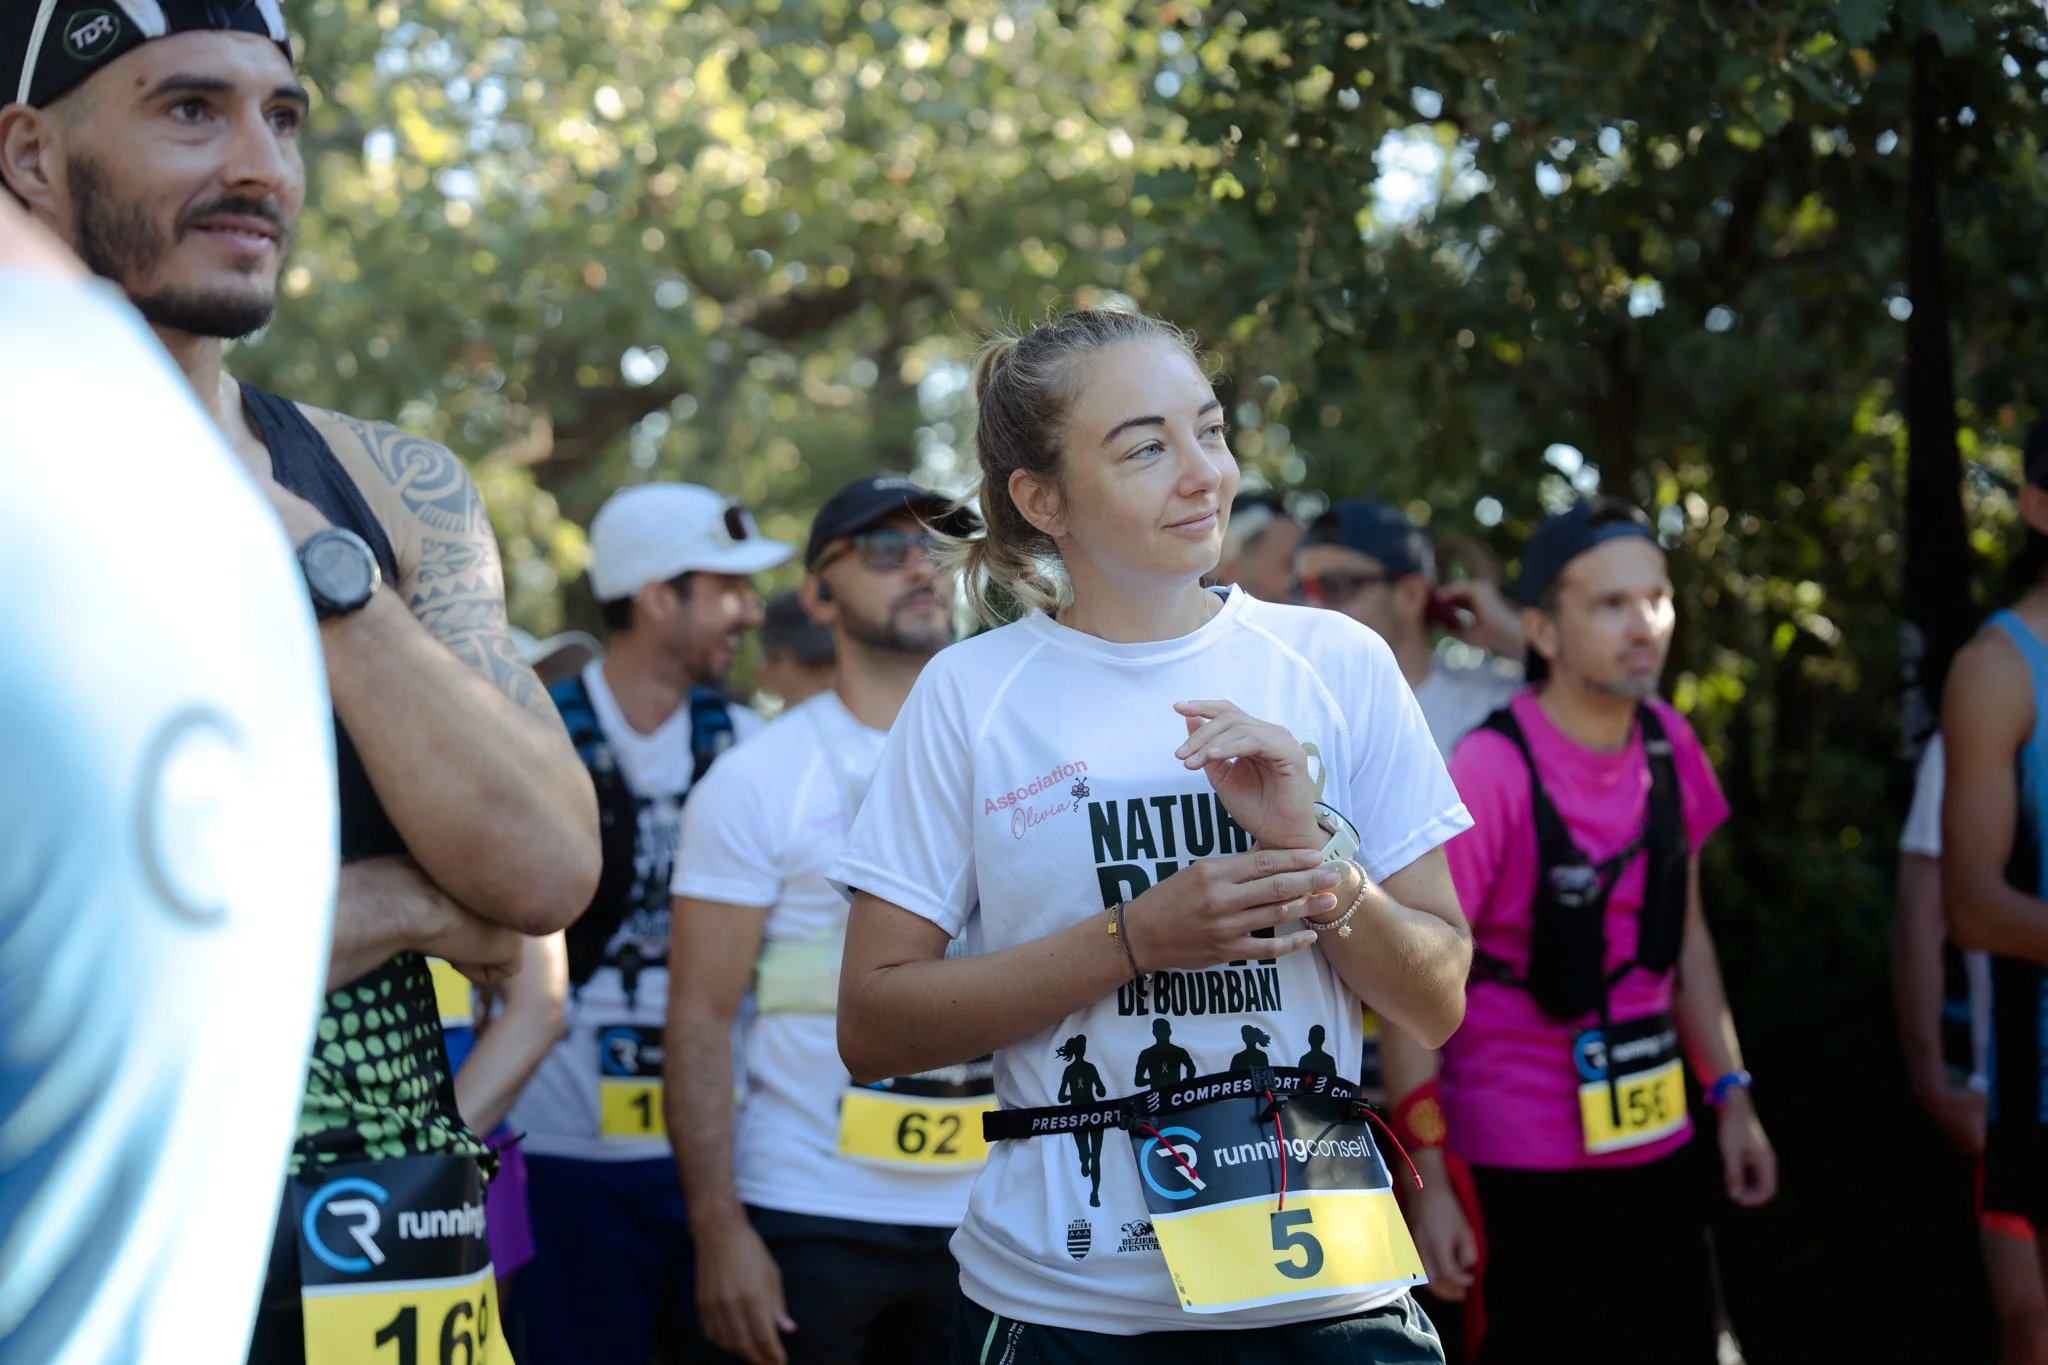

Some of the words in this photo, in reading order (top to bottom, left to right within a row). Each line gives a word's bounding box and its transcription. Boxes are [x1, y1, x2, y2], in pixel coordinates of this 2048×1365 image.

[70, 14, 113, 50] TDR
[984, 760, 1089, 816] Association
[1010, 799, 1072, 841] Olivia
[1088, 792, 1256, 864] NATUR
[1150, 967, 1282, 1017] BOURBAKI
[895, 1111, 962, 1155] 62
[1269, 1208, 1325, 1280] 5
